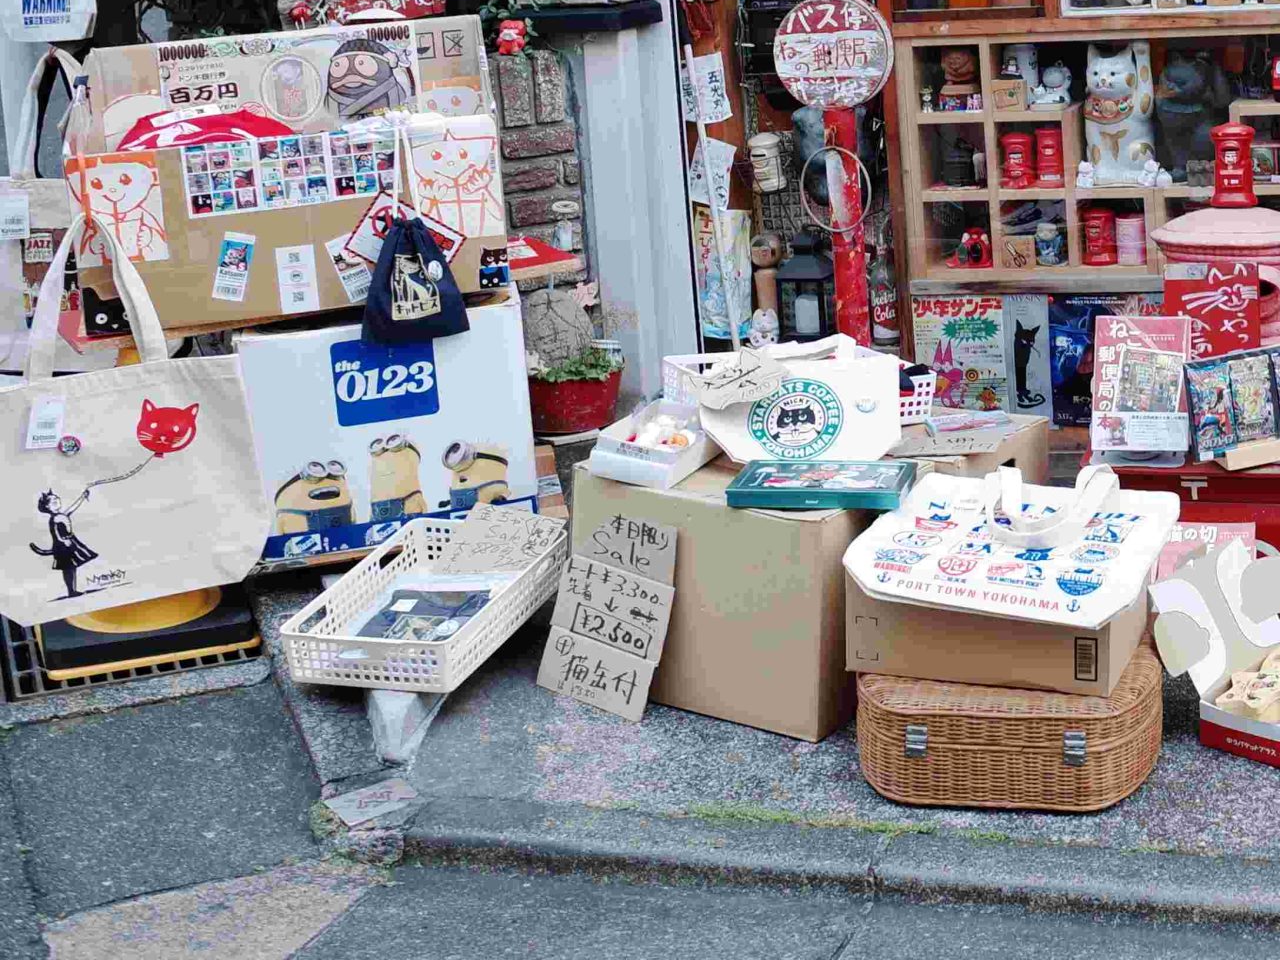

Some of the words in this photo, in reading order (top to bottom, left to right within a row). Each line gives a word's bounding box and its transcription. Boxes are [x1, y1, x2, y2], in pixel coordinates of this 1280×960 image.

[786, 2, 868, 33] バス停
[168, 82, 239, 104] 百万円
[873, 306, 896, 322] Cola
[334, 360, 361, 373] the
[336, 361, 434, 403] 0123
[783, 397, 811, 407] NICKY
[808, 382, 840, 422] COFFEE
[761, 434, 833, 459] YOKOHAMA
[610, 514, 669, 551] 本日限り
[592, 530, 650, 572] Sale
[896, 578, 934, 593] PORT
[936, 583, 977, 600] TOWN
[982, 590, 1060, 613] YOKOHAMA
[560, 653, 639, 705] 猫缶付
[1225, 735, 1278, 758] ゆうパケットプラス
